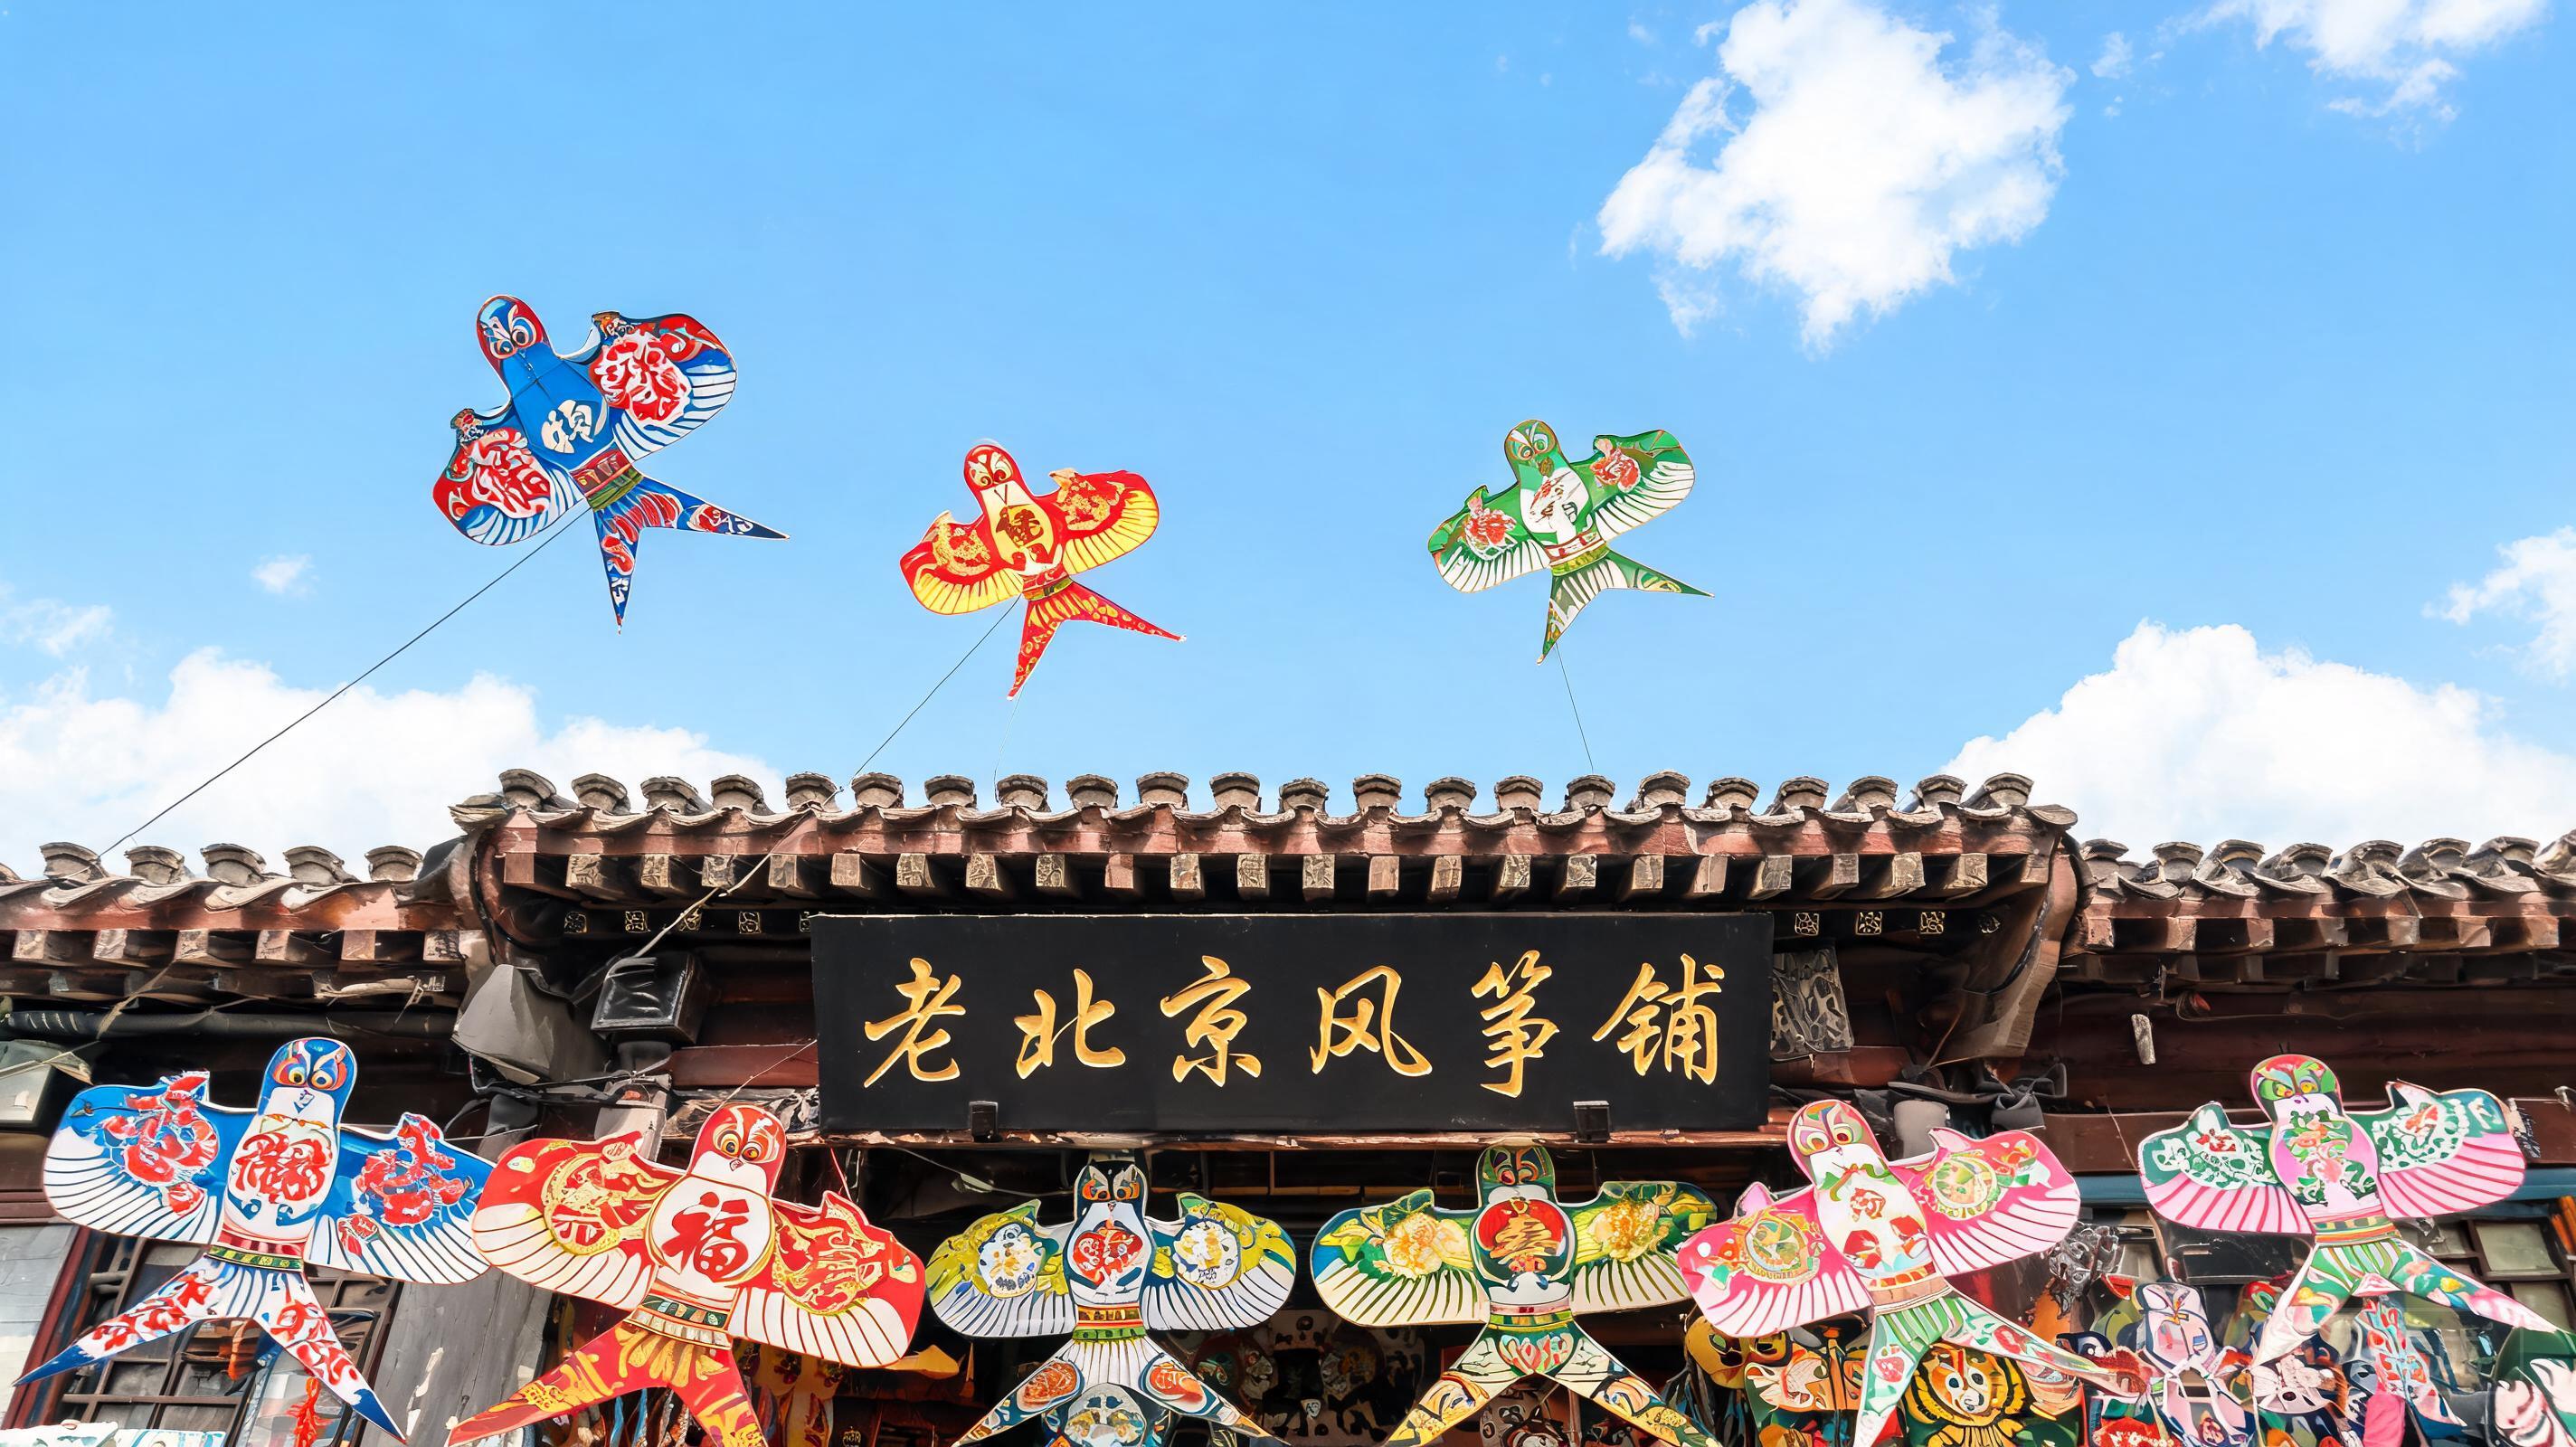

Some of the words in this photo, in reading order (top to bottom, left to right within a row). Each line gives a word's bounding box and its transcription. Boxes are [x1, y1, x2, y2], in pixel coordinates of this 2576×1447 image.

[864, 950, 1725, 1097] 老北京风筝铺
[662, 1191, 749, 1282] 福
